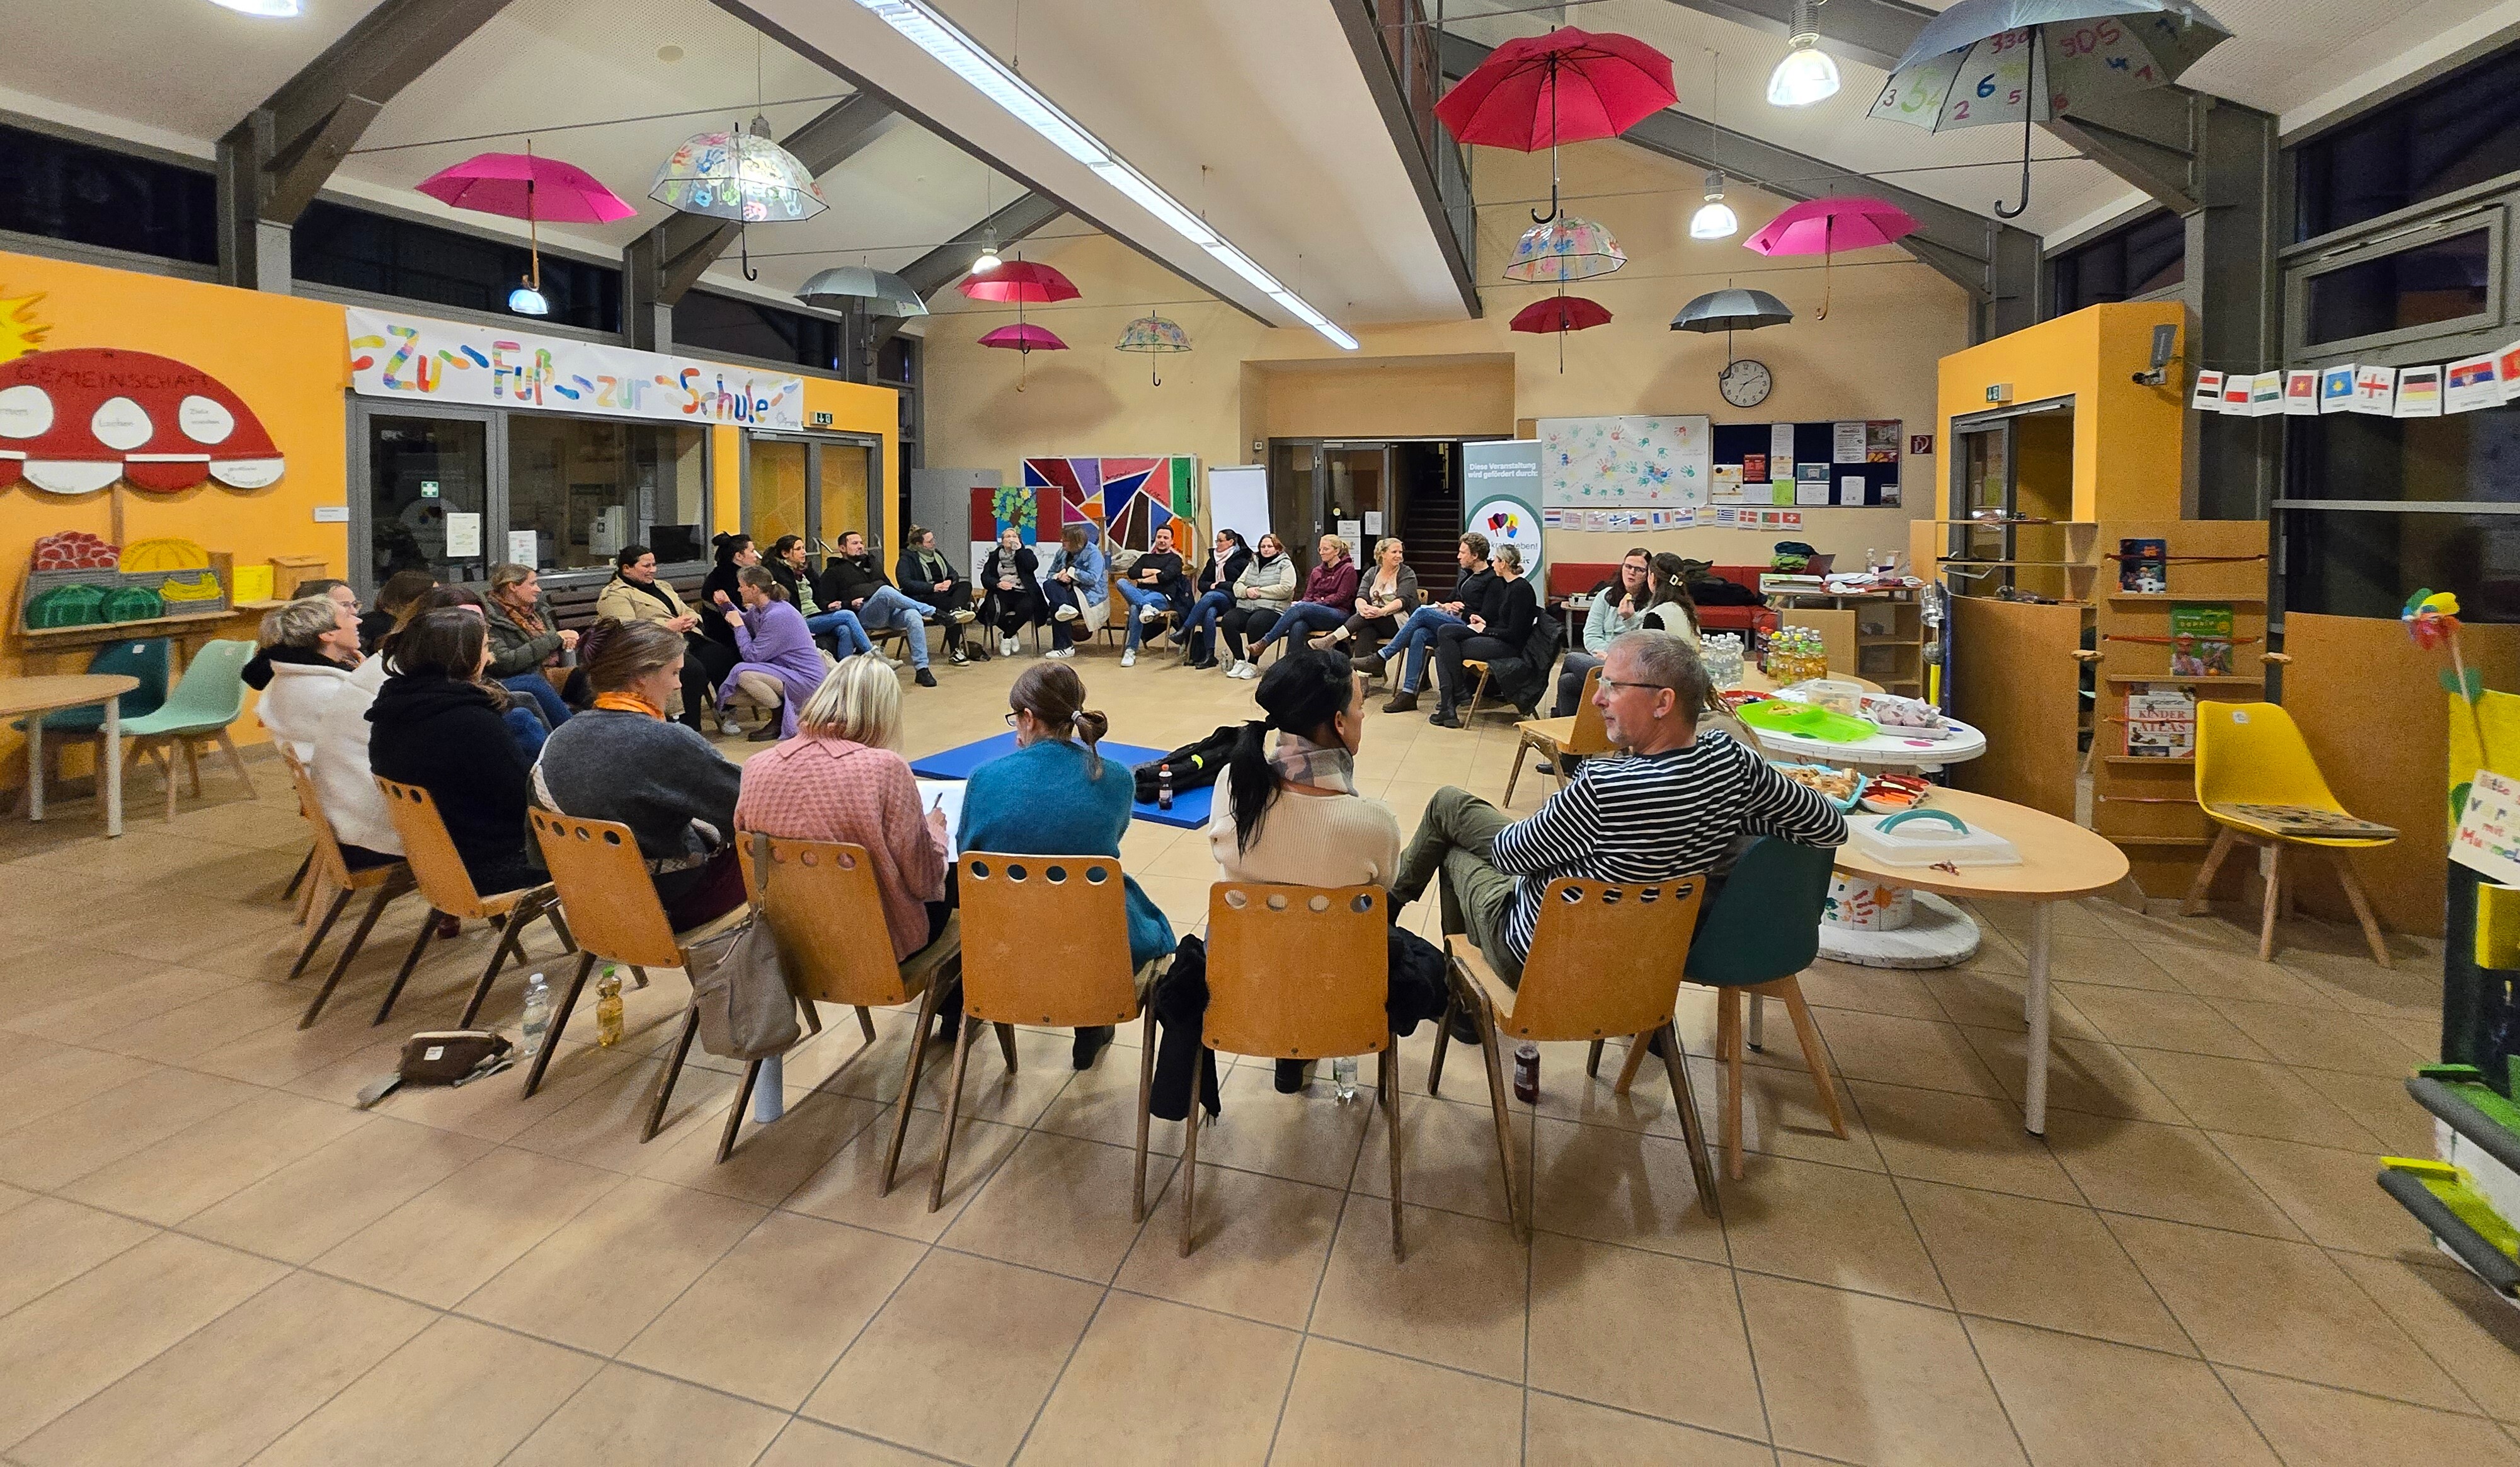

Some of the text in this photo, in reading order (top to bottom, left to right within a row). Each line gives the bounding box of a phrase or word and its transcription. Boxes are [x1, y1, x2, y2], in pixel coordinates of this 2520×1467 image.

[1976, 72, 1996, 98] 6
[1883, 89, 1897, 106] 3
[2007, 89, 2022, 105] 5
[1954, 100, 1970, 120] 2
[383, 325, 769, 424] Zu Fuß zur Schule
[1489, 462, 1536, 470] Veranstaltung
[1483, 470, 1515, 479] gefördert
[2139, 710, 2185, 718] KINDER
